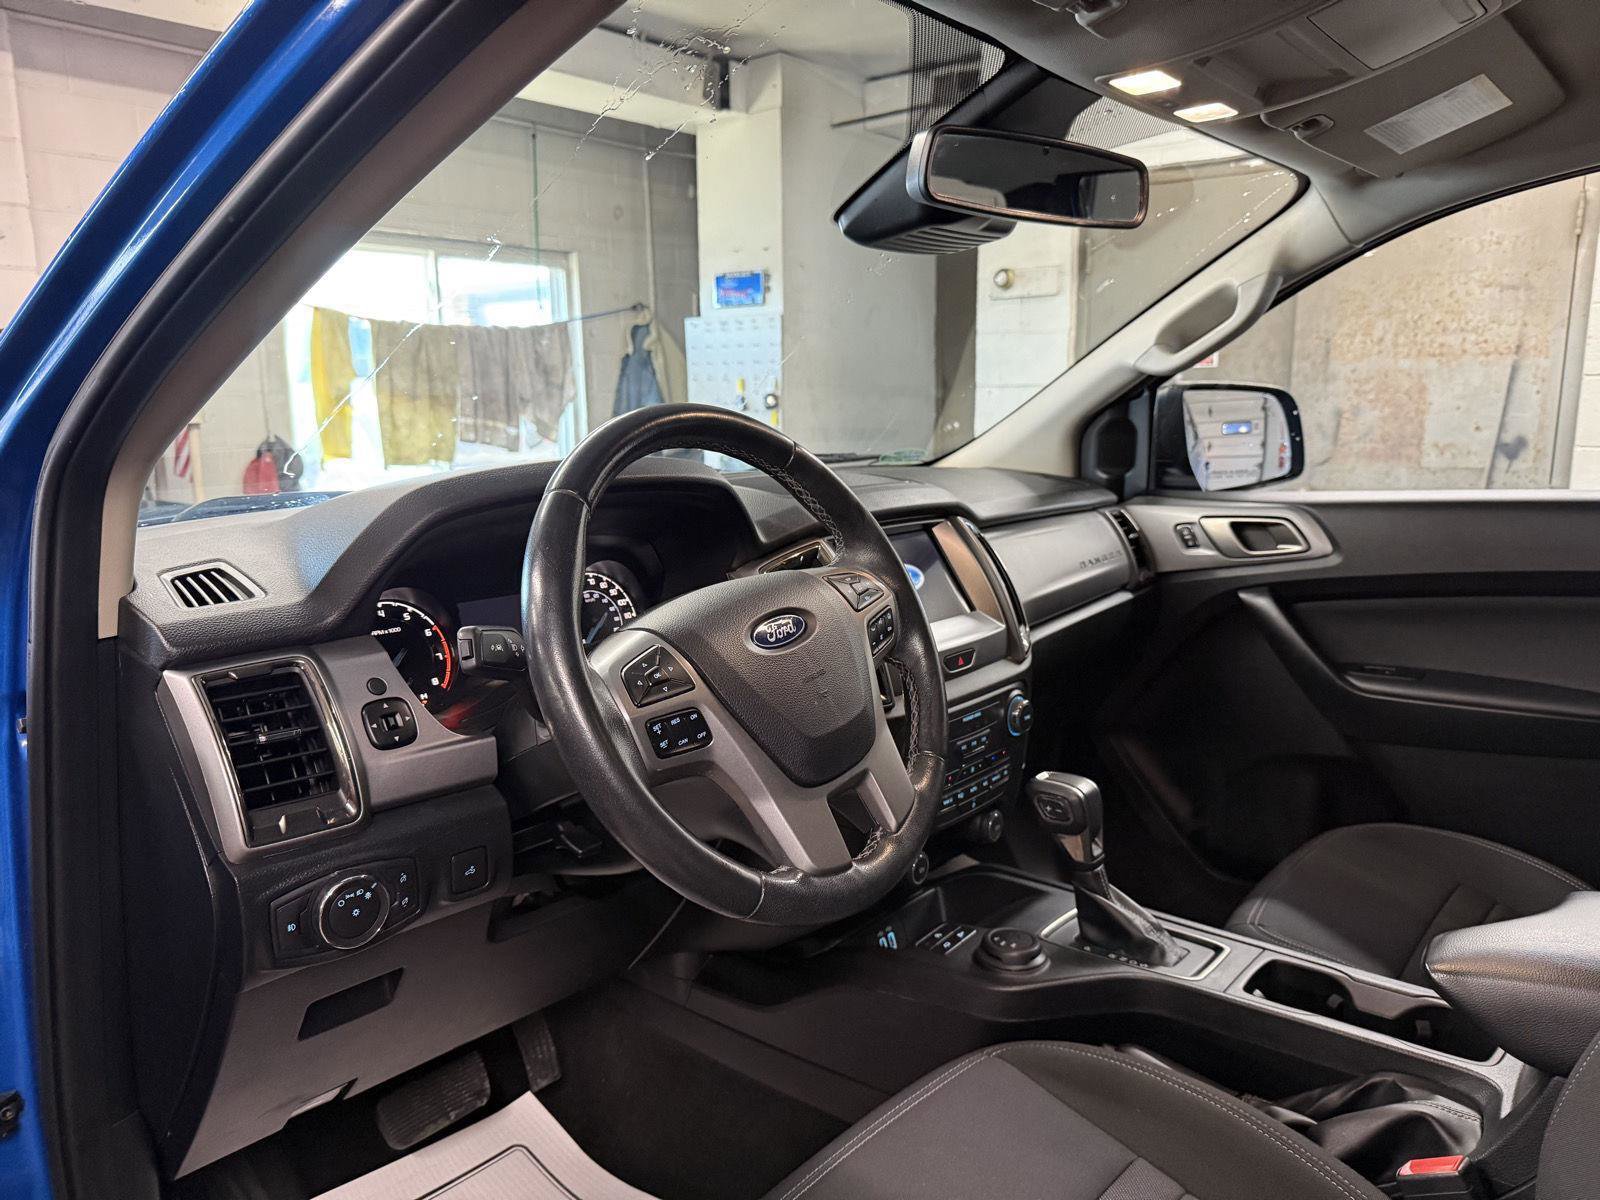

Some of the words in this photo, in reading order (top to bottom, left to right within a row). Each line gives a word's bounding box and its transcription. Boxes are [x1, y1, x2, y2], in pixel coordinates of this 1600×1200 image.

[403, 612, 411, 621] 5
[424, 628, 432, 637] 6
[764, 617, 797, 642] Ford
[435, 652, 444, 661] 7
[670, 717, 681, 726] RES
[690, 713, 698, 721] ON
[652, 722, 662, 732] SET
[697, 731, 707, 739] OFF
[678, 737, 689, 746] CAN
